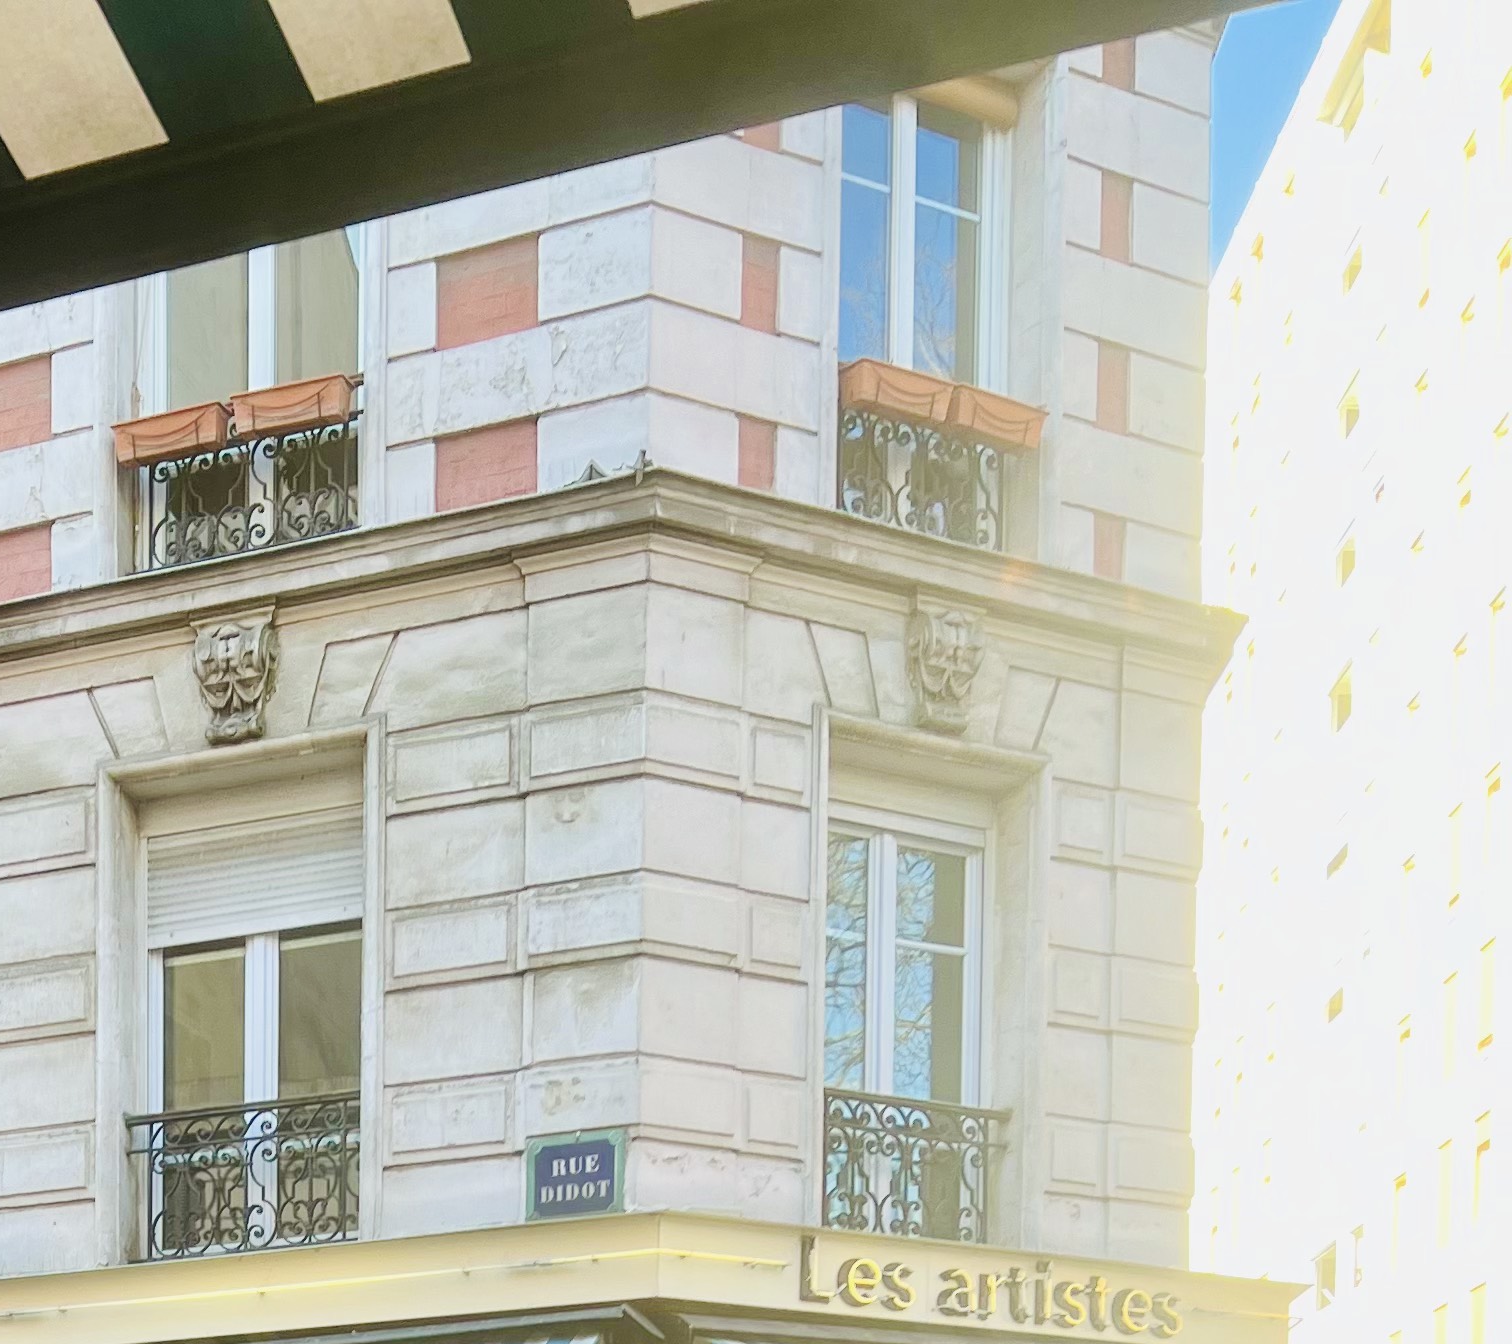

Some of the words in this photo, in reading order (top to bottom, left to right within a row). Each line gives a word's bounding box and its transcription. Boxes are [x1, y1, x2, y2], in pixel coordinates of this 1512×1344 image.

[551, 1153, 600, 1178] RUE
[540, 1179, 611, 1204] DIDOT
[800, 1234, 917, 1311] Les
[936, 1259, 1184, 1338] artistes
